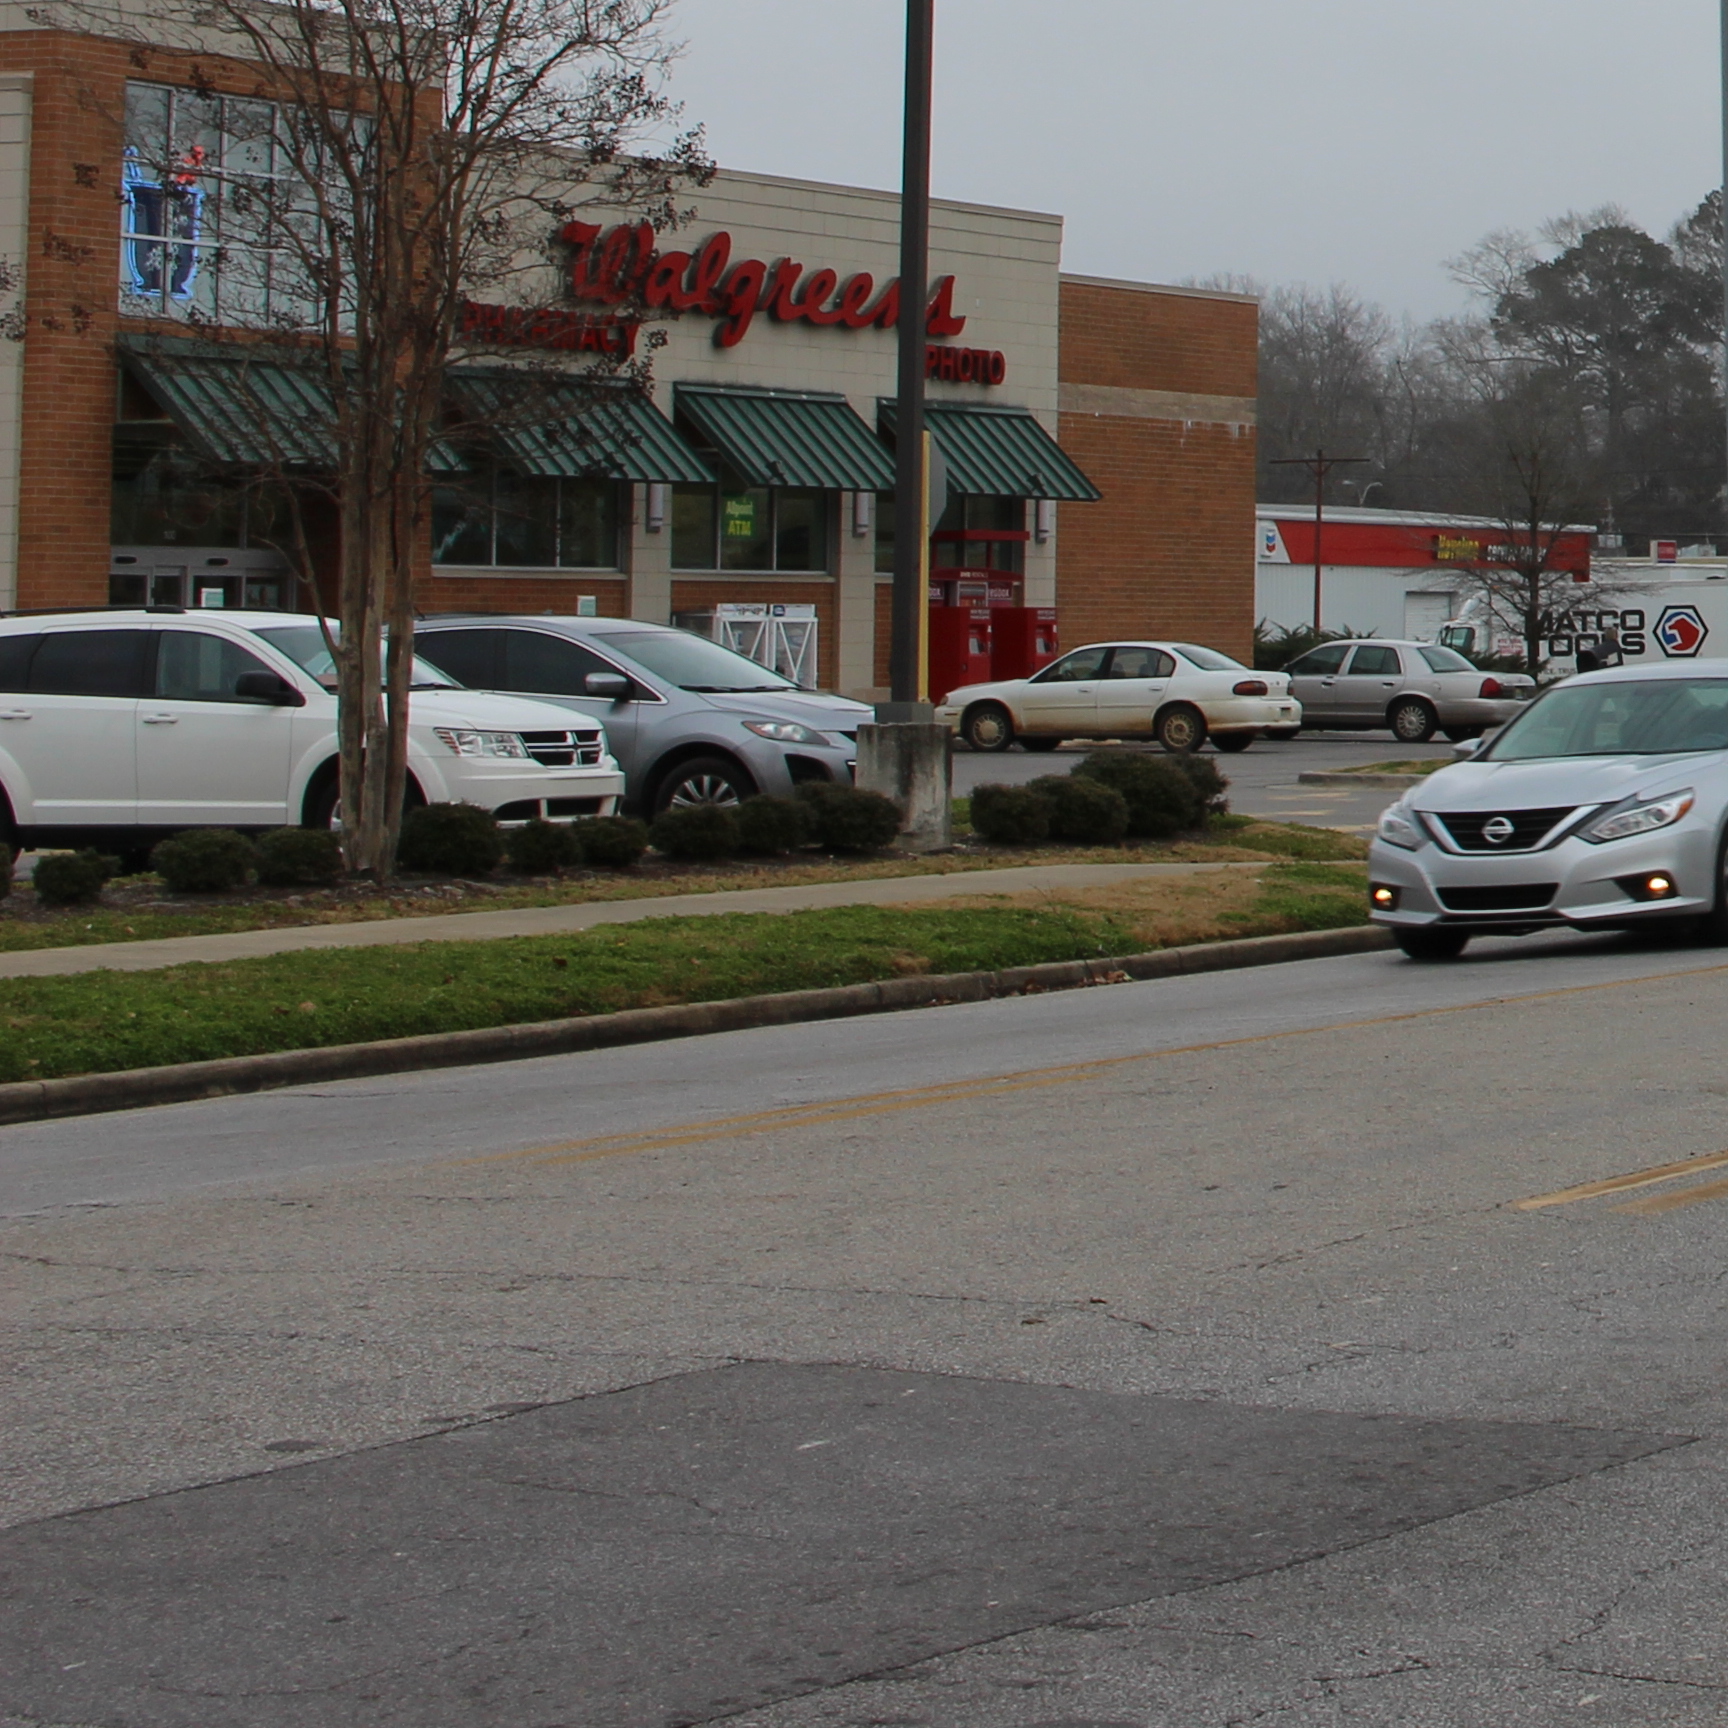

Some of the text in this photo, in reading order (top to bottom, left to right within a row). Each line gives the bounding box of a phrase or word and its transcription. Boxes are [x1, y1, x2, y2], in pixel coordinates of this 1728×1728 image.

[924, 344, 1006, 385] PHOTO
[727, 520, 752, 536] ATM
[1523, 632, 1646, 657] TOOS
